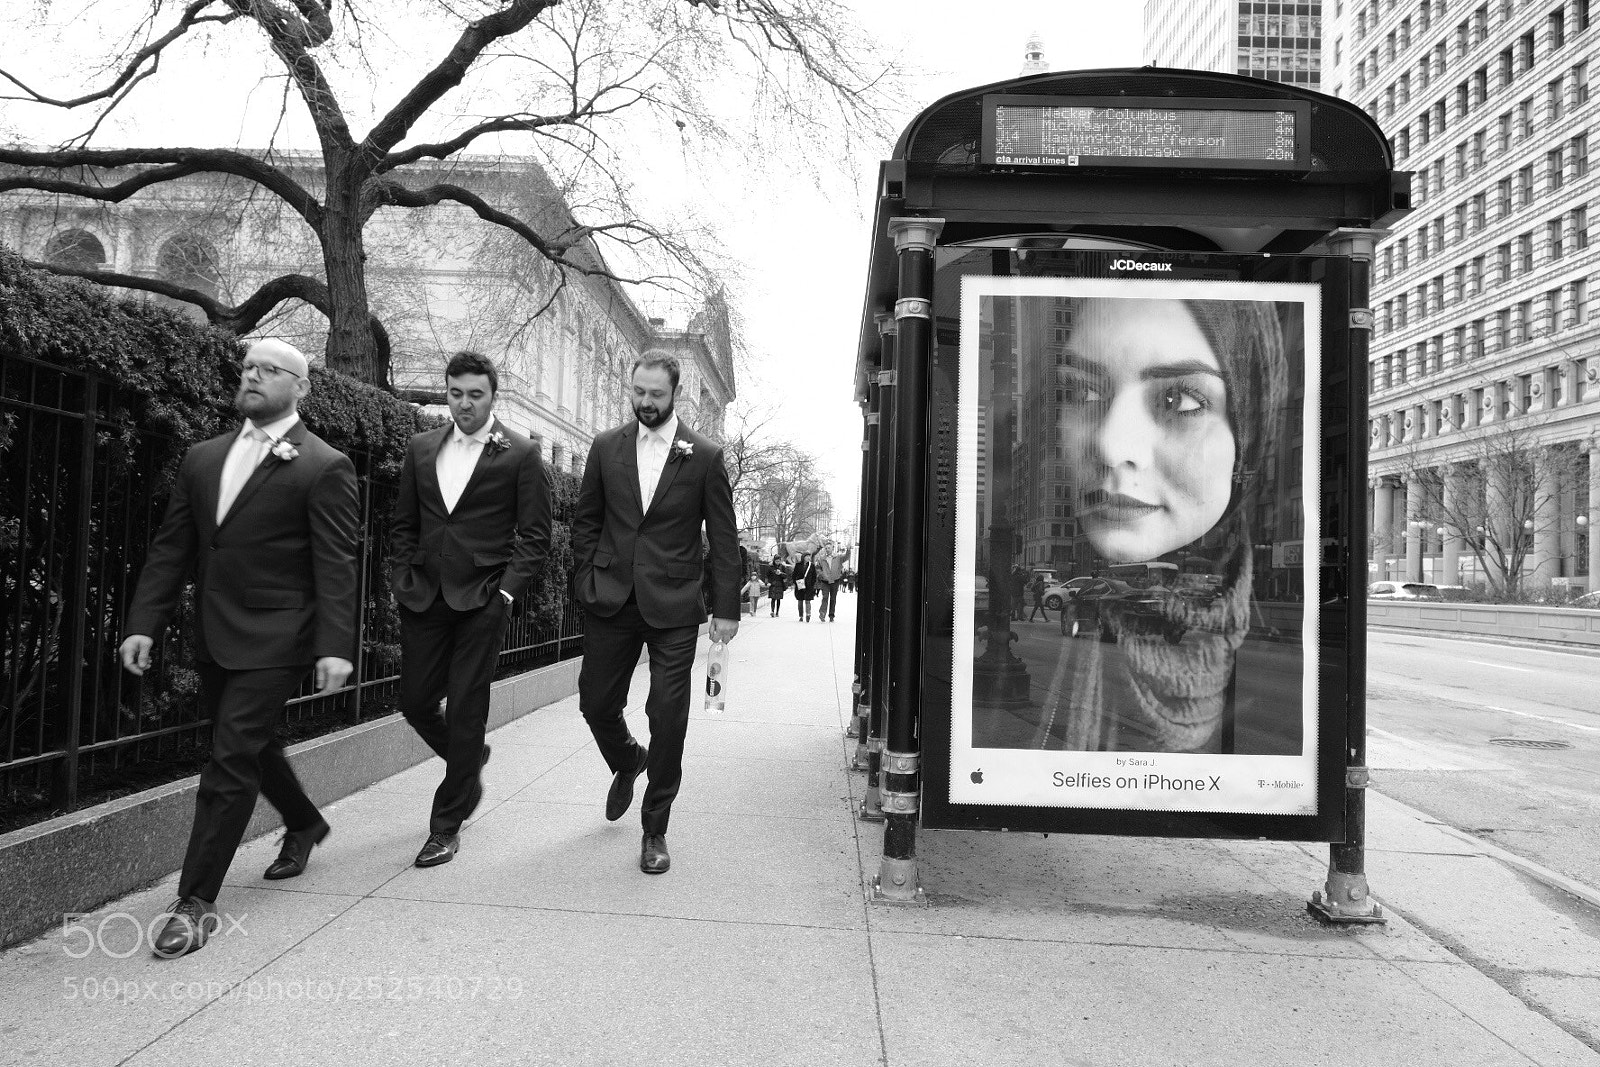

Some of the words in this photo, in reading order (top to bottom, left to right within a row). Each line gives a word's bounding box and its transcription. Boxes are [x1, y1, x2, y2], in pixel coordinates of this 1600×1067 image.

[996, 155, 1011, 163] cta
[1013, 156, 1040, 164] arrival
[1042, 156, 1066, 165] times
[1109, 259, 1172, 271] JCDecaux
[1116, 757, 1126, 767] by
[1128, 758, 1148, 766] Sara
[1053, 771, 1111, 789] Selfies
[1116, 776, 1138, 789] on
[1143, 773, 1206, 791] iPhone
[1208, 775, 1221, 791] X
